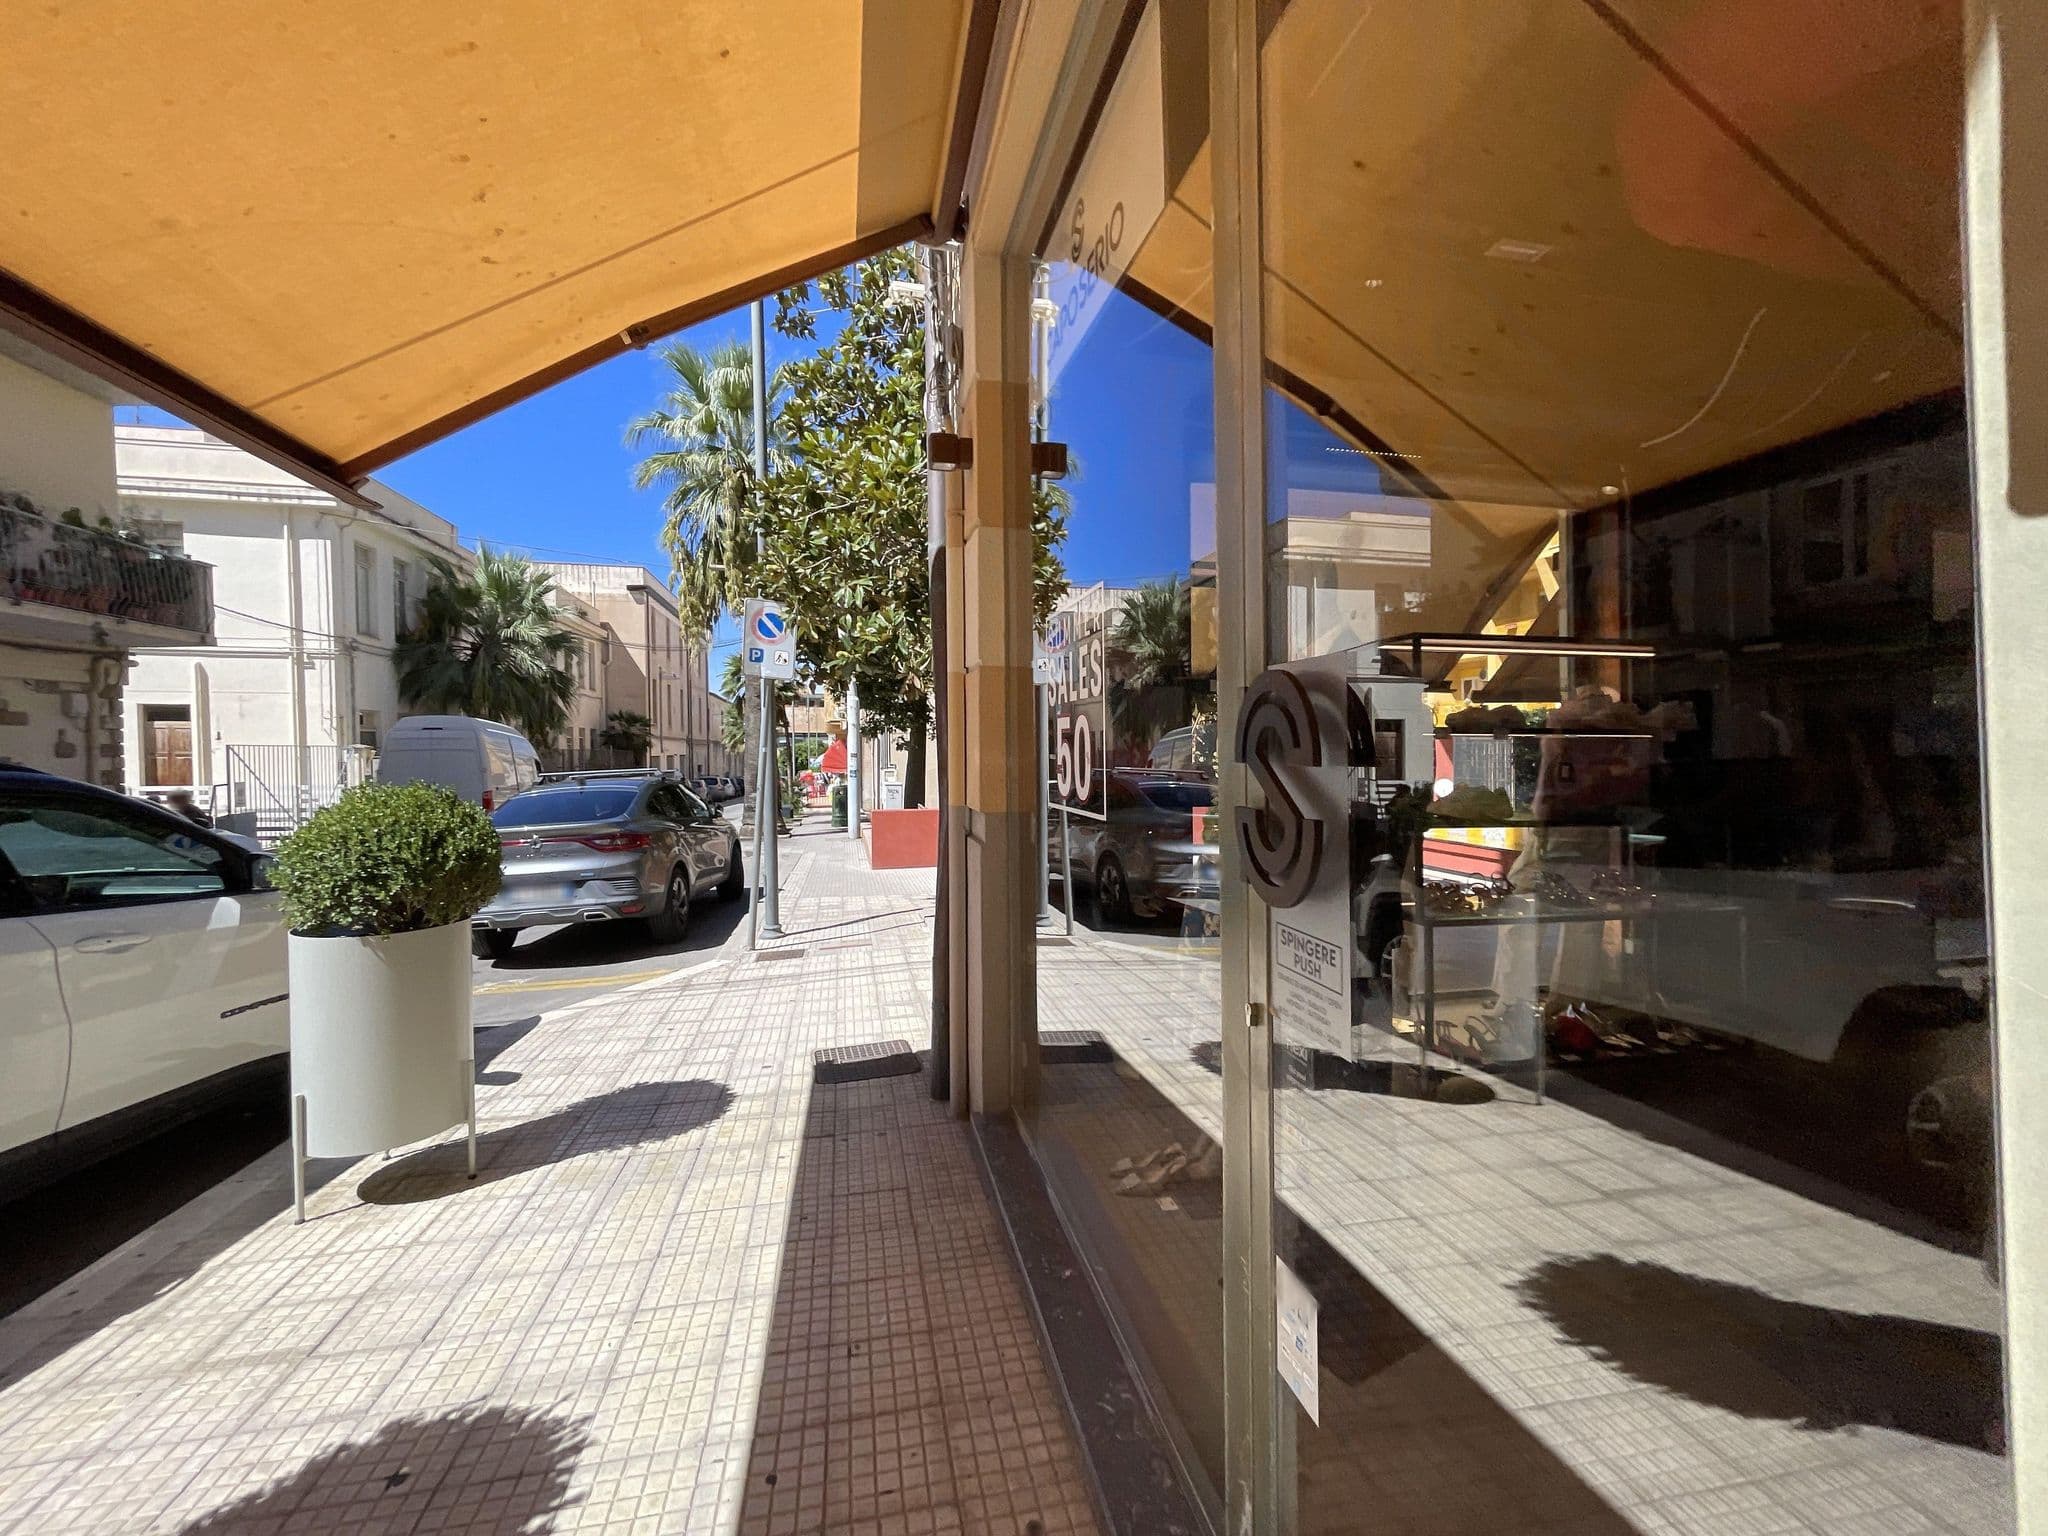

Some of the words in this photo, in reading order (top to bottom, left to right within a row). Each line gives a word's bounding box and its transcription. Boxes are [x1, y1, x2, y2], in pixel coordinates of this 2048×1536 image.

[751, 650, 761, 661] P
[1047, 638, 1102, 707] SALES
[1057, 714, 1091, 804] 50
[1281, 929, 1337, 968] SPINGERE
[1294, 954, 1322, 980] PUSH
